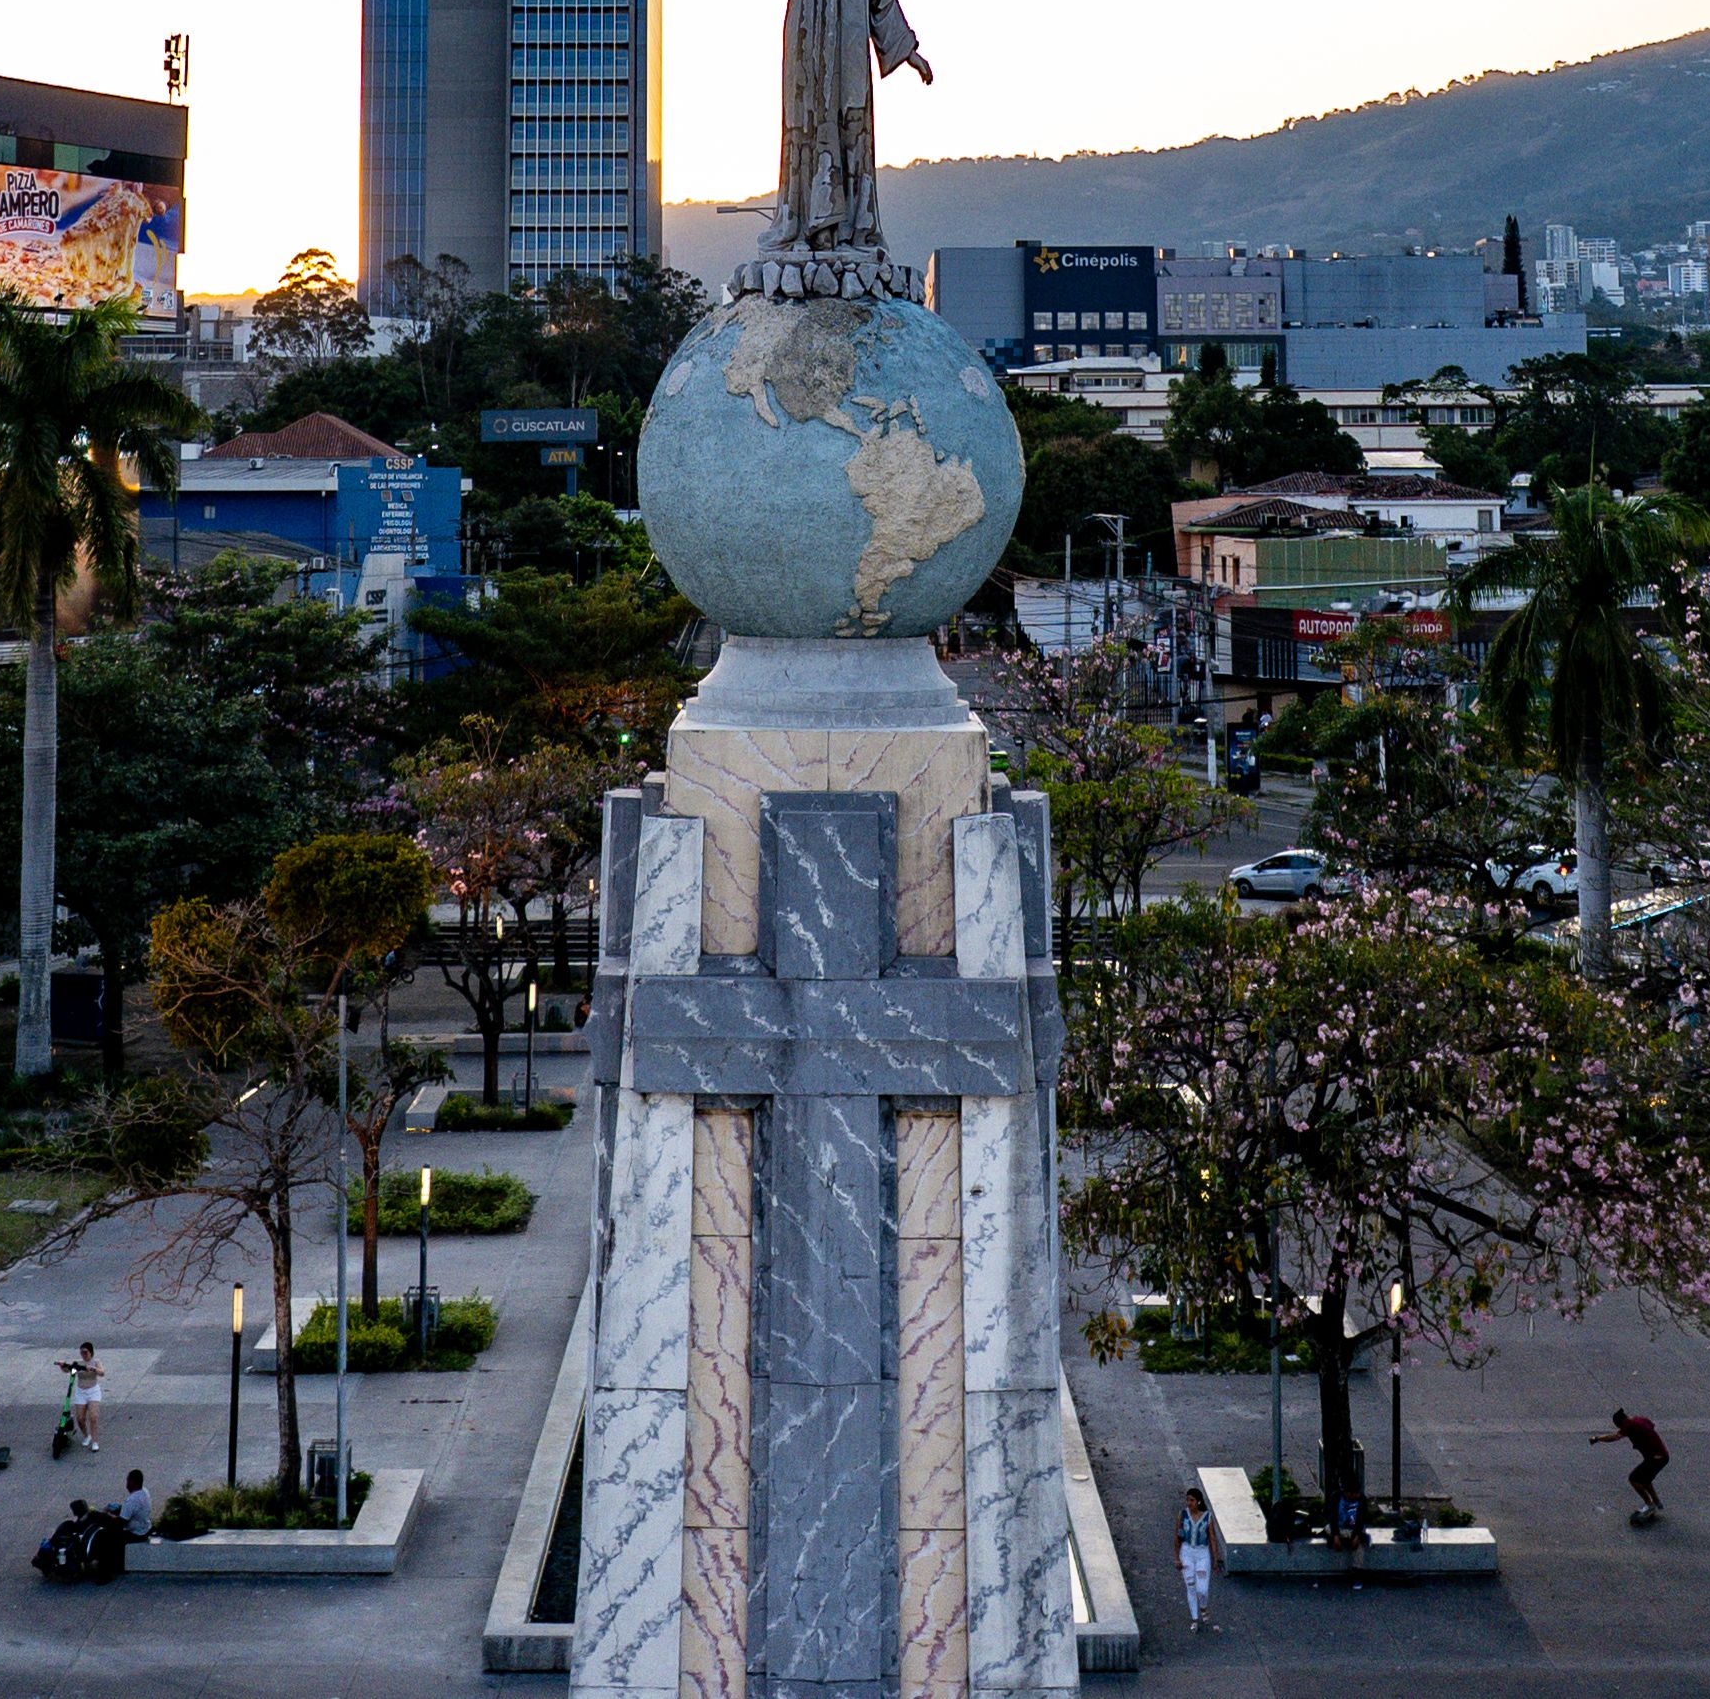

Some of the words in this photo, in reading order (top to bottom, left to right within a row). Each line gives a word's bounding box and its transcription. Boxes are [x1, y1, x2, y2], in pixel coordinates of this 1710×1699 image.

[6, 172, 37, 192] PIZZA
[1061, 253, 1138, 270] Cinépolis
[512, 421, 585, 432] CUSCATLAN
[548, 451, 577, 463] ATM
[386, 459, 414, 470] CSSP
